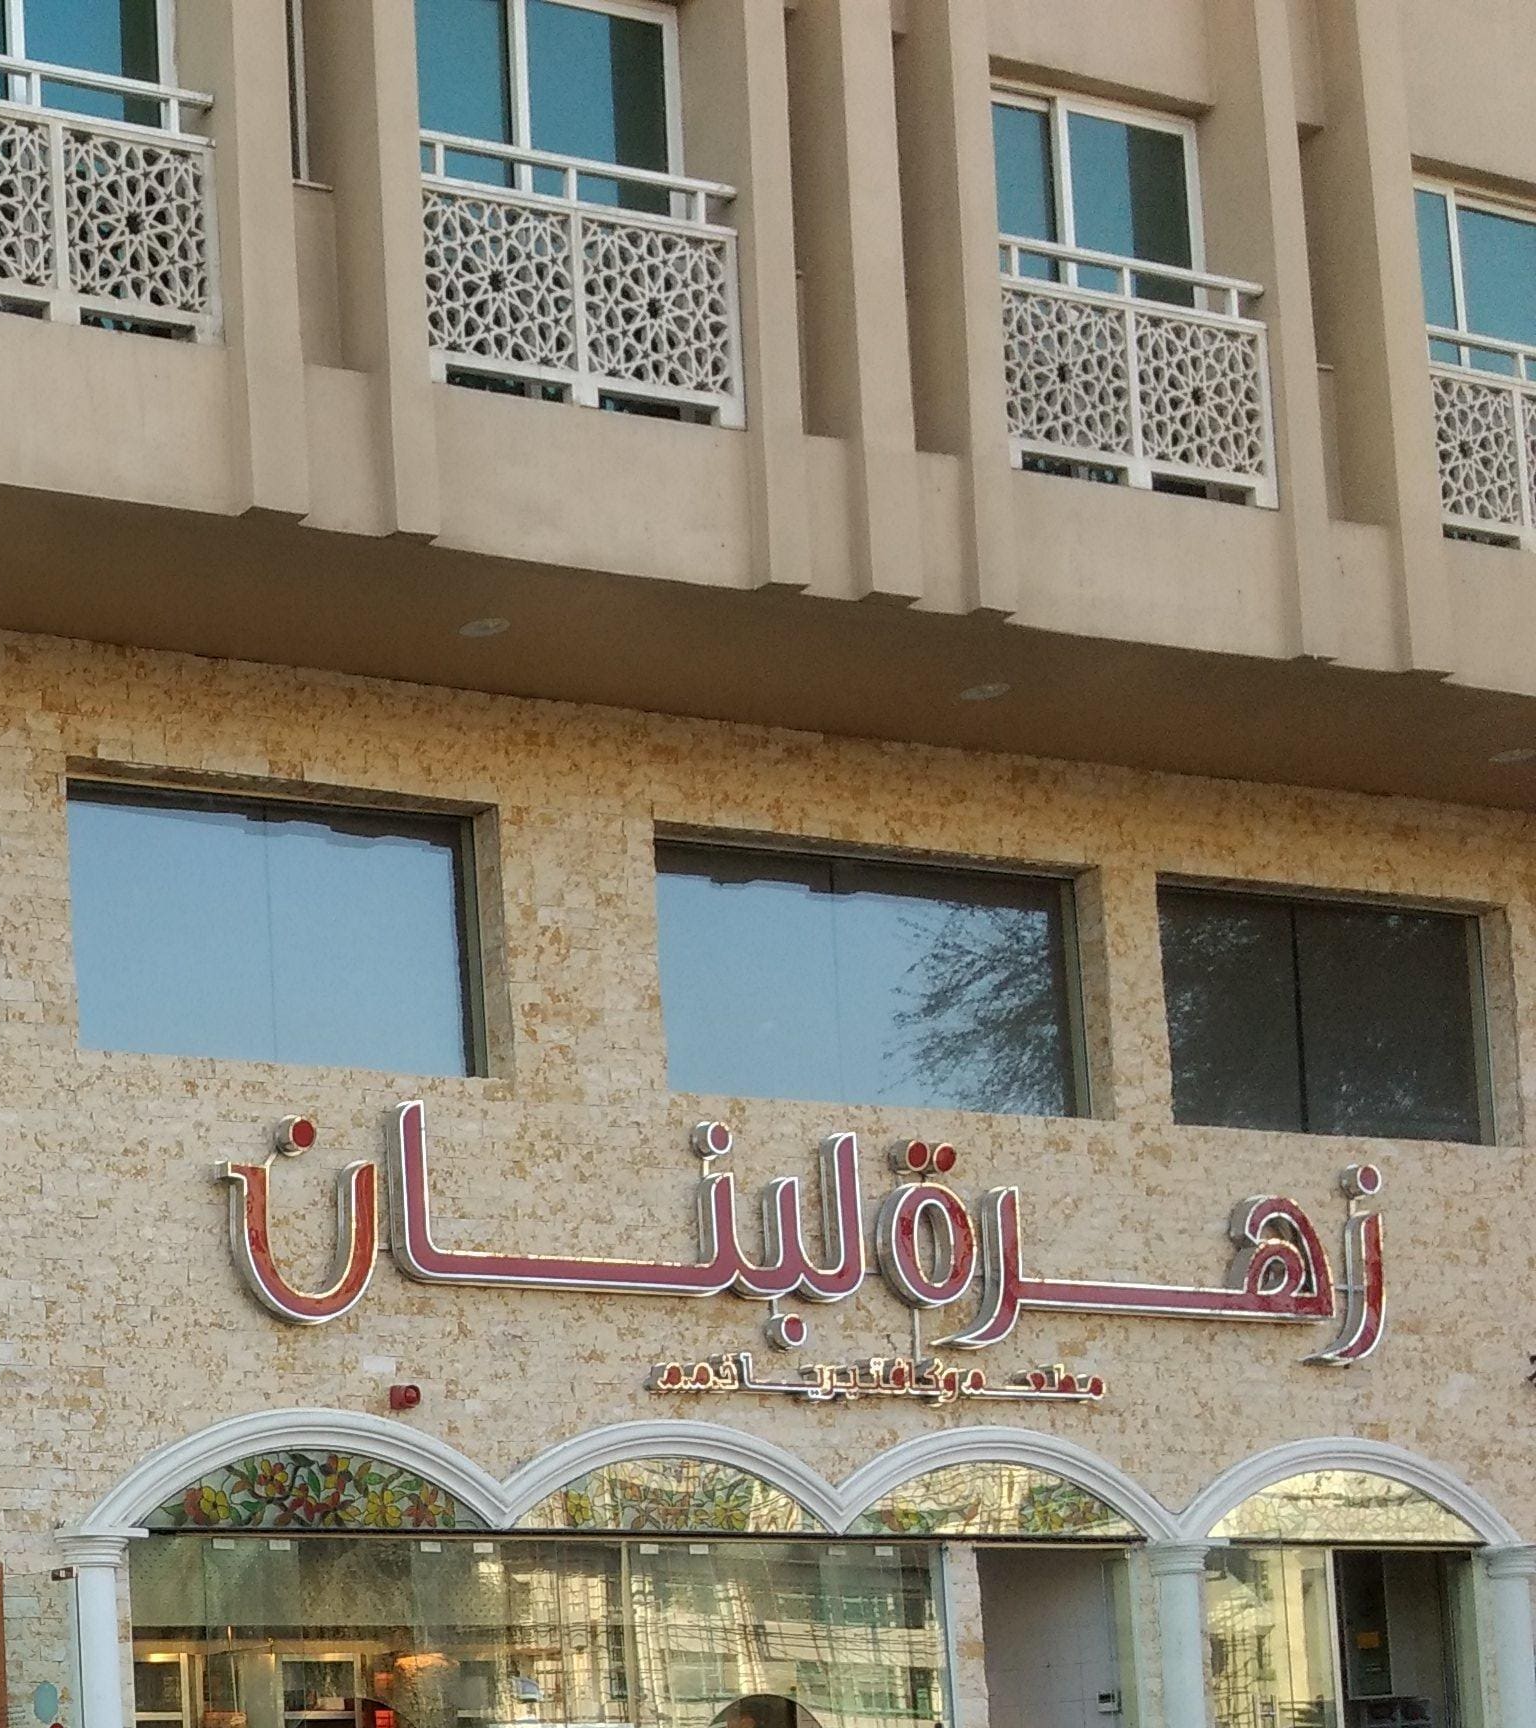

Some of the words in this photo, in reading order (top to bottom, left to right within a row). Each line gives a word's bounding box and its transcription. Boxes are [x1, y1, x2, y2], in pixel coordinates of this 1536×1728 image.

[214, 1099, 866, 1349] لبنان
[876, 1138, 1385, 1367] زهرة
[961, 1362, 1108, 1400] مطعم
